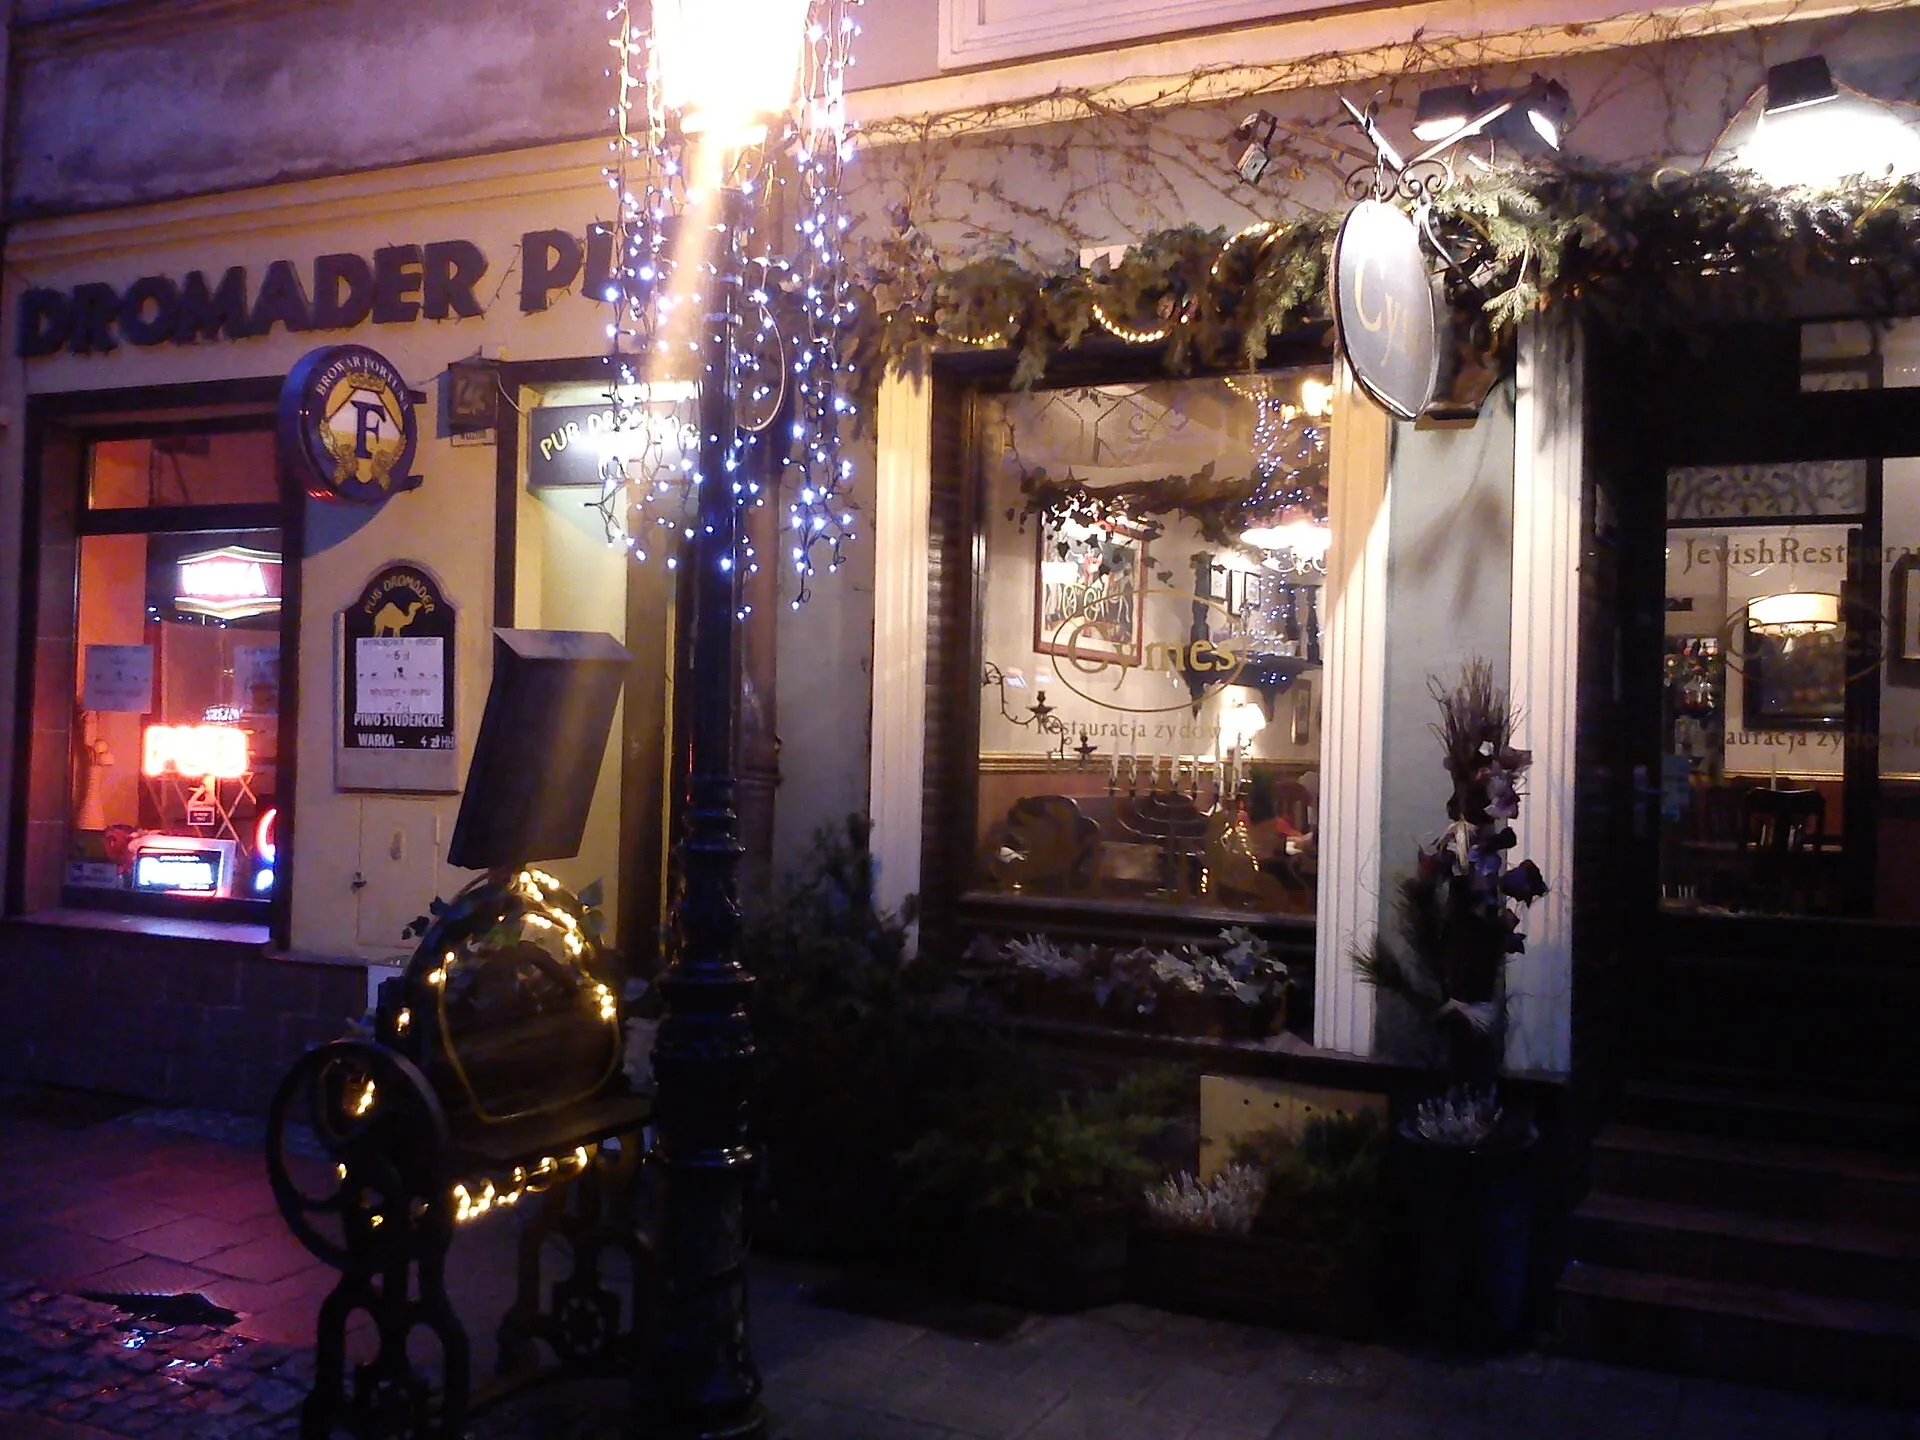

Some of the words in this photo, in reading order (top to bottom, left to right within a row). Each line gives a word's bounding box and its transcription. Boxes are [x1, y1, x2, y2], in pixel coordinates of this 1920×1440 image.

[17, 239, 489, 358] DROMADER
[316, 356, 361, 397] BROWAR
[540, 421, 581, 461] PUB
[1067, 621, 1237, 692] Cymes
[353, 713, 380, 727] PIWO
[383, 713, 445, 728] STUDENCKIE
[358, 733, 395, 748] WARKA
[1036, 720, 1147, 747] Restauracja
